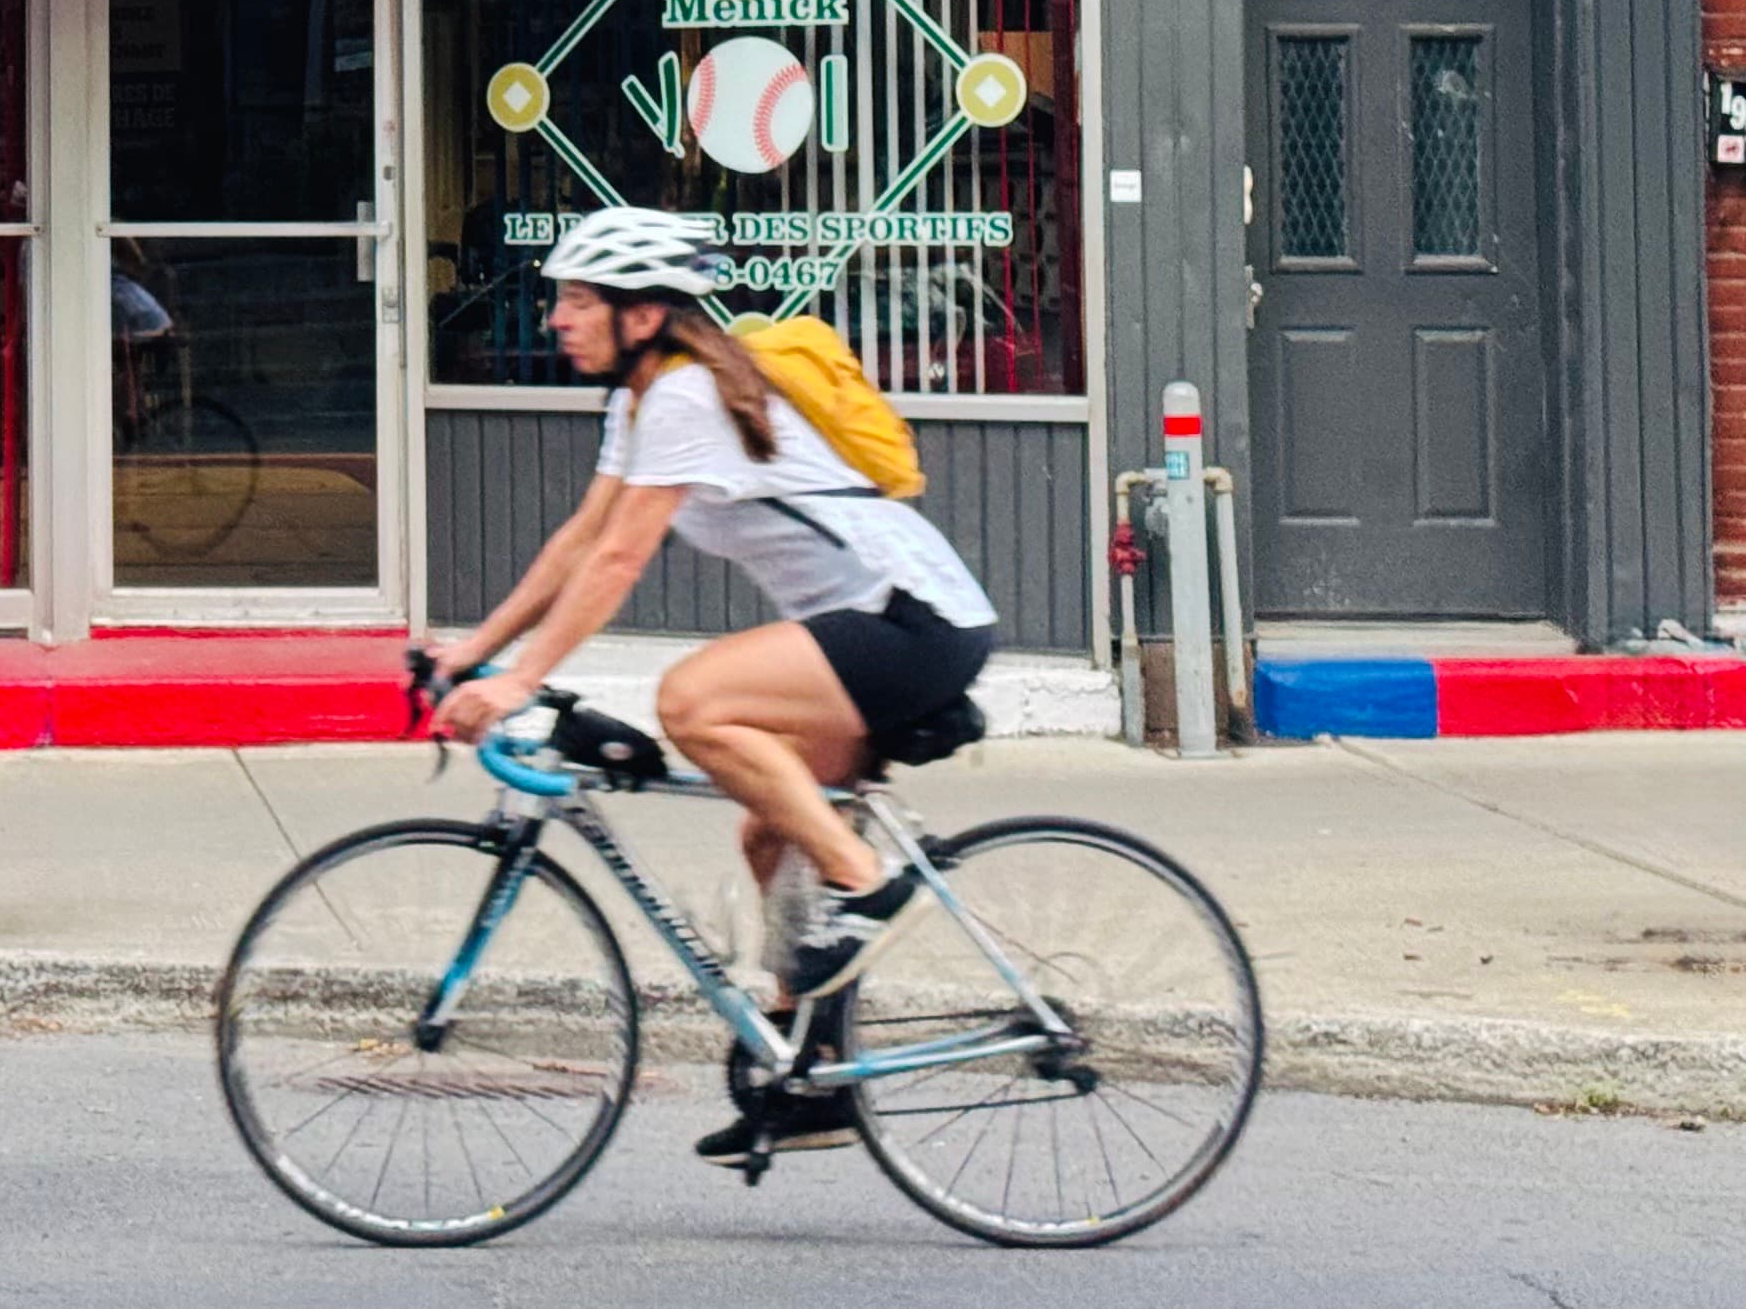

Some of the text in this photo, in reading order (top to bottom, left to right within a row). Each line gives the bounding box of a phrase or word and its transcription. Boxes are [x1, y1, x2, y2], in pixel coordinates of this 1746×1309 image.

[507, 215, 552, 241] LE
[737, 216, 809, 241] DES
[821, 216, 1011, 242] SPORTIFS
[715, 261, 840, 288] 8-0467
